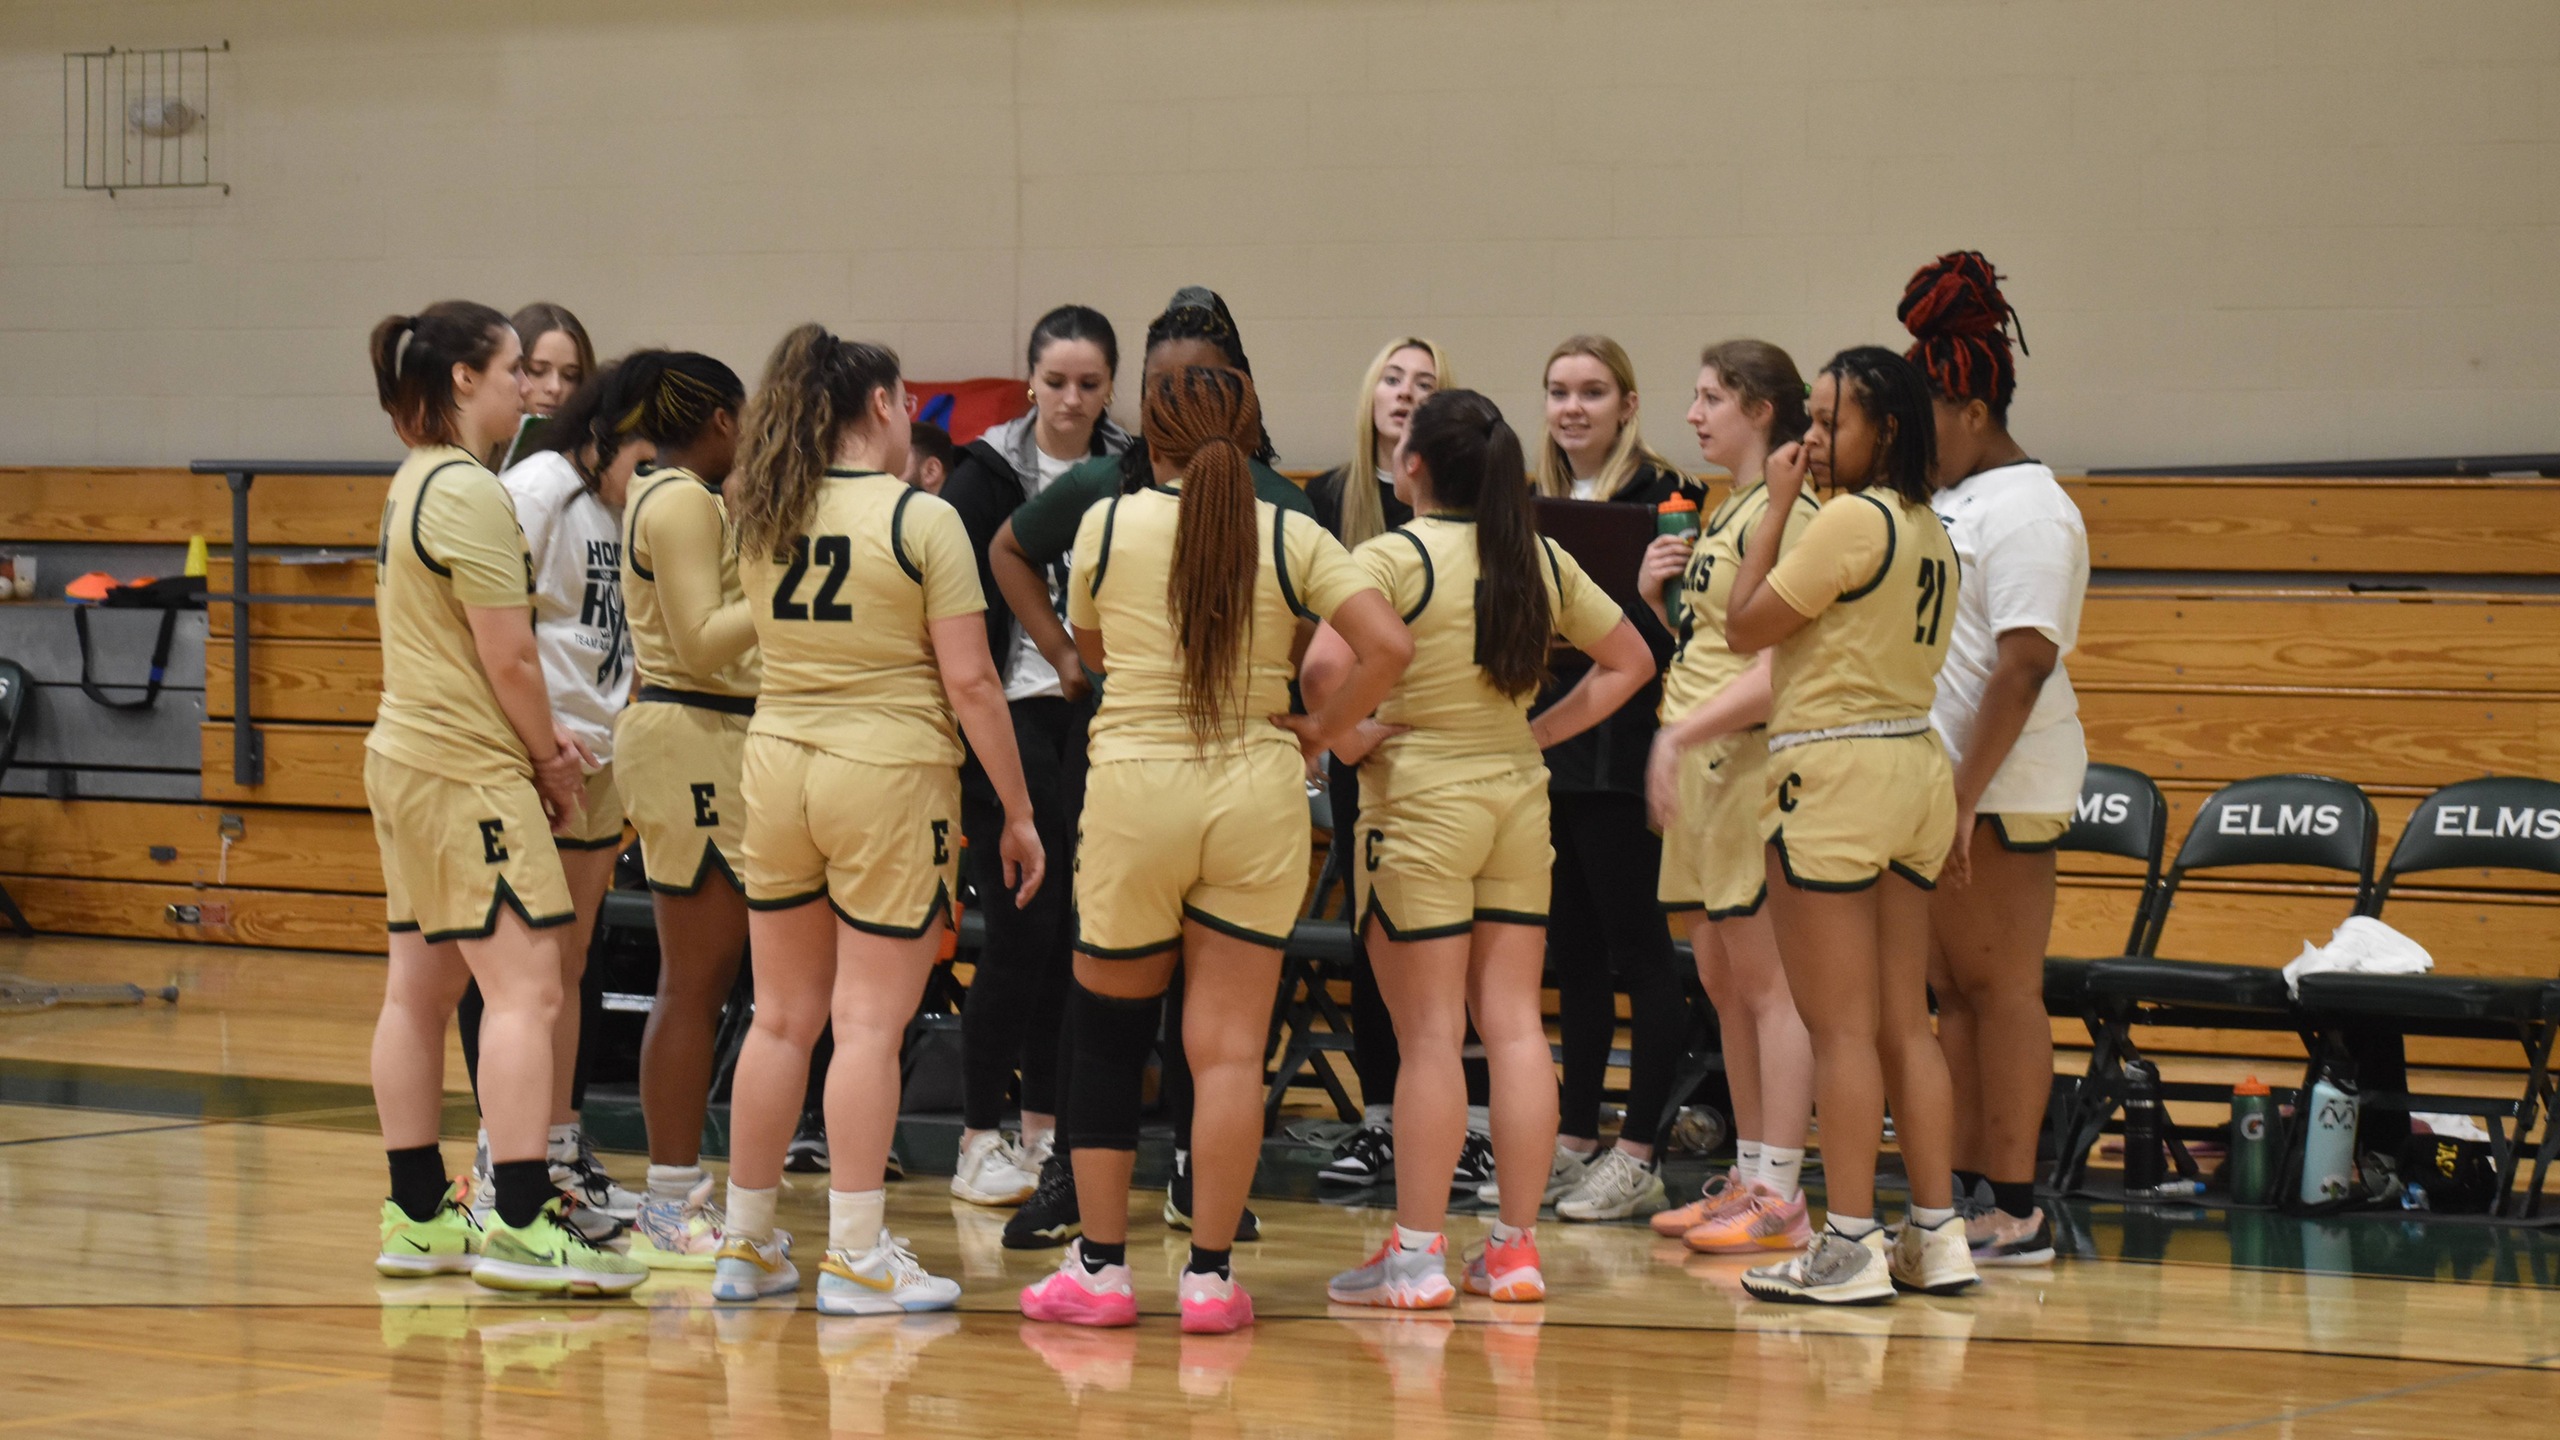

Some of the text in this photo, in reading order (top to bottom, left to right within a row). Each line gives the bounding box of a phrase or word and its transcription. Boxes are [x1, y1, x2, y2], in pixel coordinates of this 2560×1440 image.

[772, 535, 852, 621] 22
[1914, 557, 1946, 645] 21
[690, 782, 719, 827] E
[1778, 772, 1802, 813] C
[2070, 794, 2131, 824] MS
[478, 818, 509, 864] E
[2218, 803, 2342, 836] ELMS
[2434, 805, 2560, 840] ELMS
[931, 819, 949, 866] E
[1366, 828, 1385, 871] C
[2241, 1112, 2264, 1140] G
